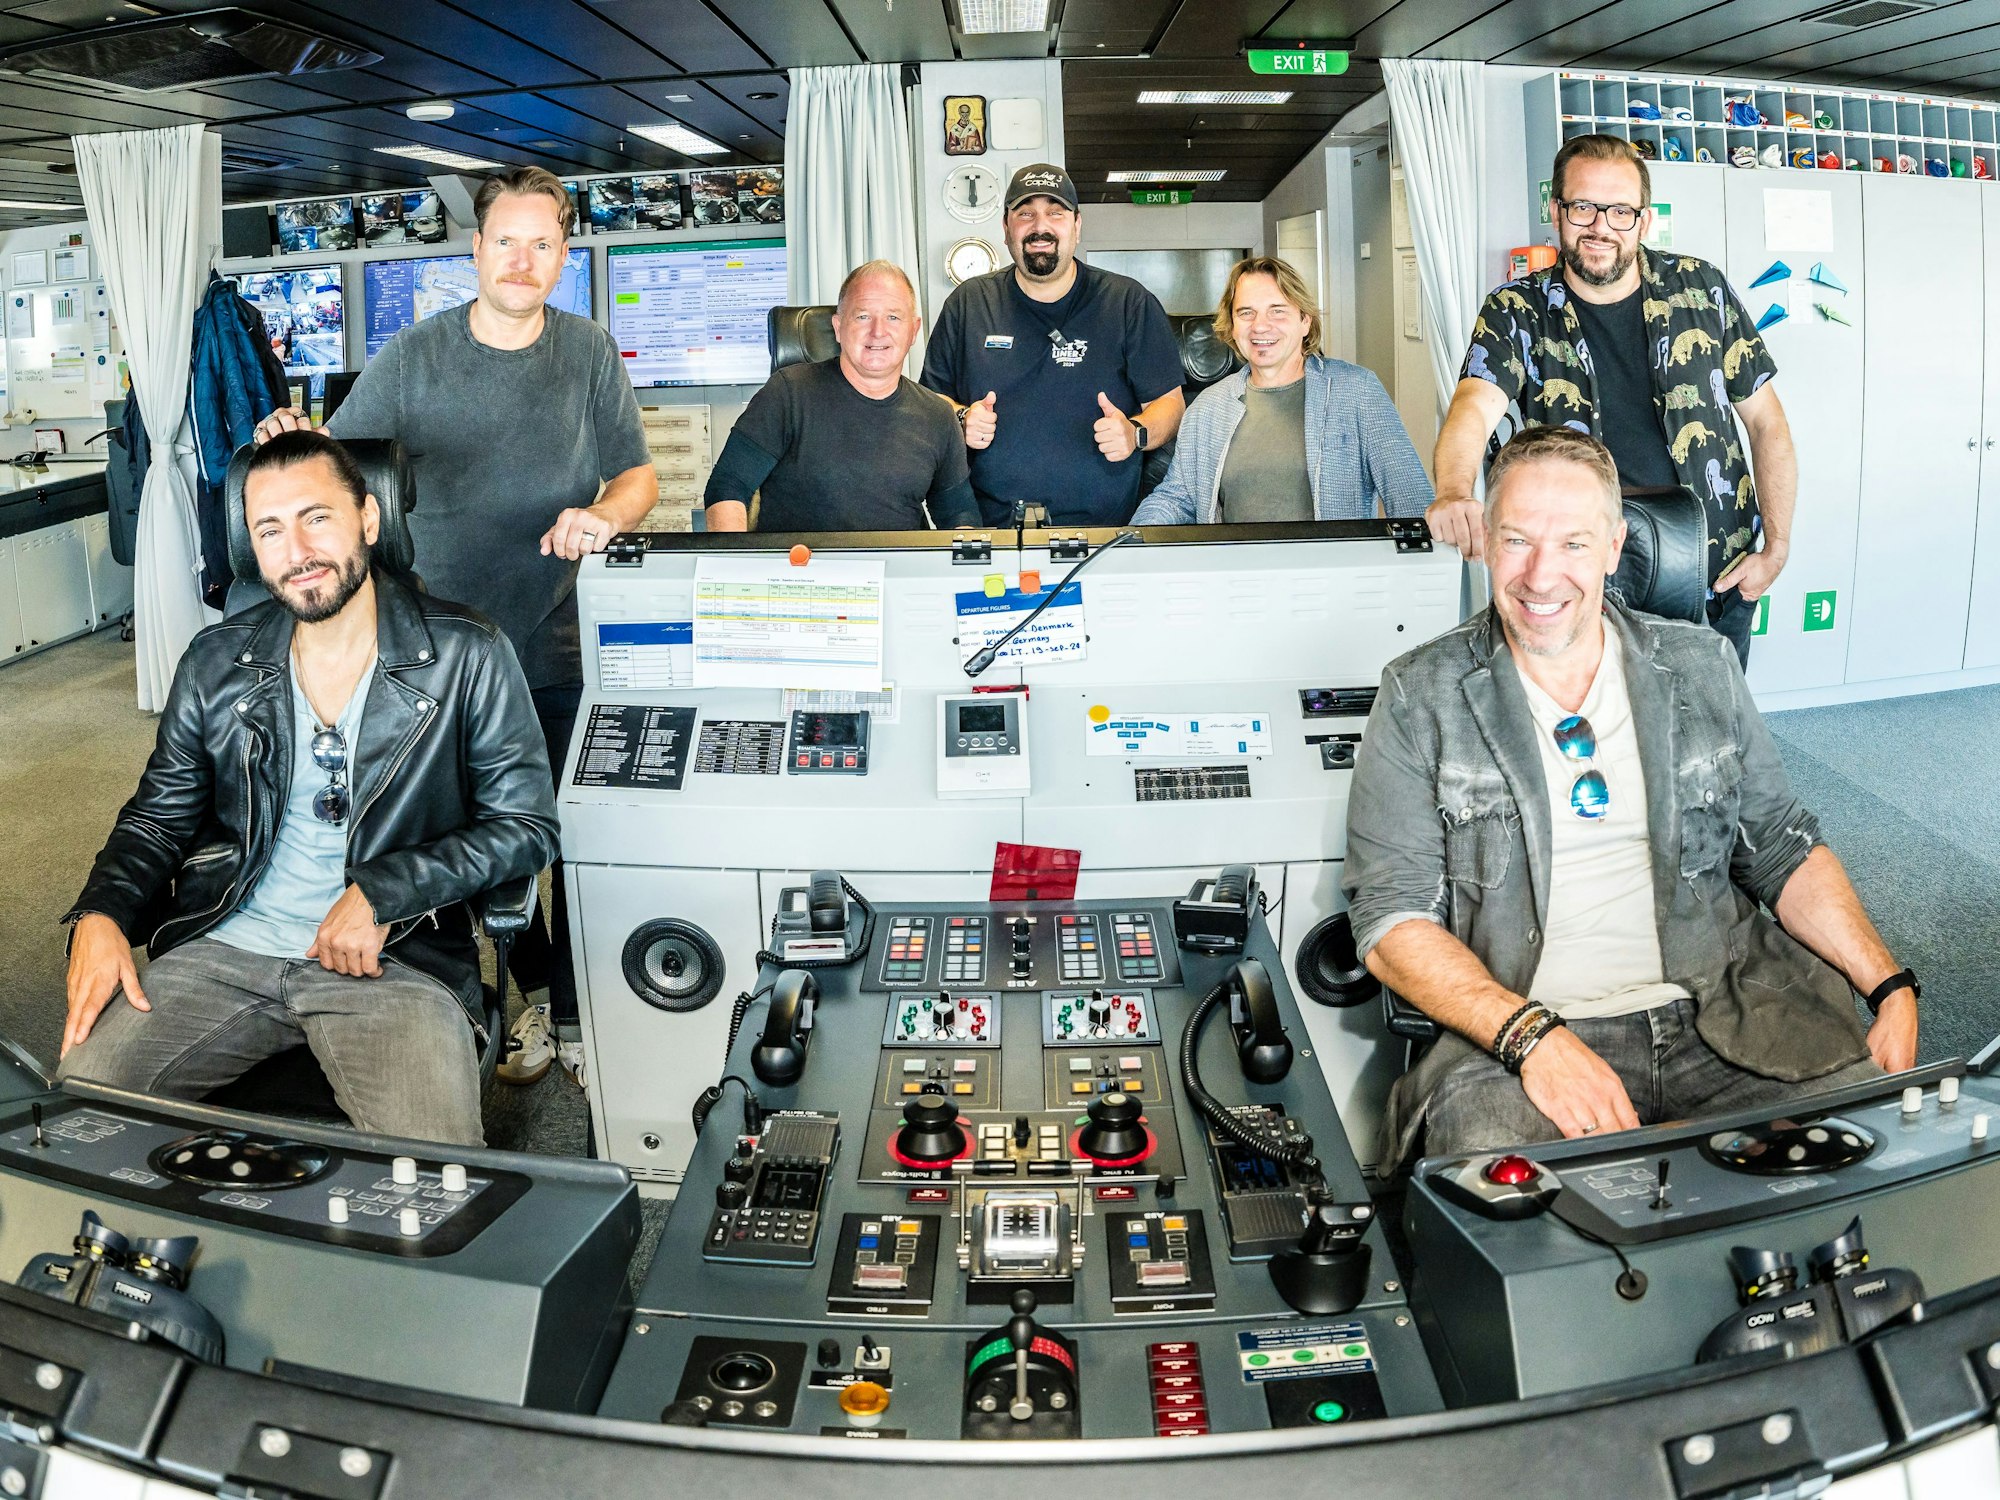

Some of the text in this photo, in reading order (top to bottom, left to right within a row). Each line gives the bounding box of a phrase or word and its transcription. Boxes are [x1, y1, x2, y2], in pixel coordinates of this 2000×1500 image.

[1273, 55, 1305, 70] EXIT
[1146, 193, 1166, 203] EXIT
[961, 606, 990, 614] DEPARTURE
[1031, 622, 1074, 633] Denmark
[1012, 636, 1050, 645] Germany
[1748, 1313, 1775, 1328] OOW
